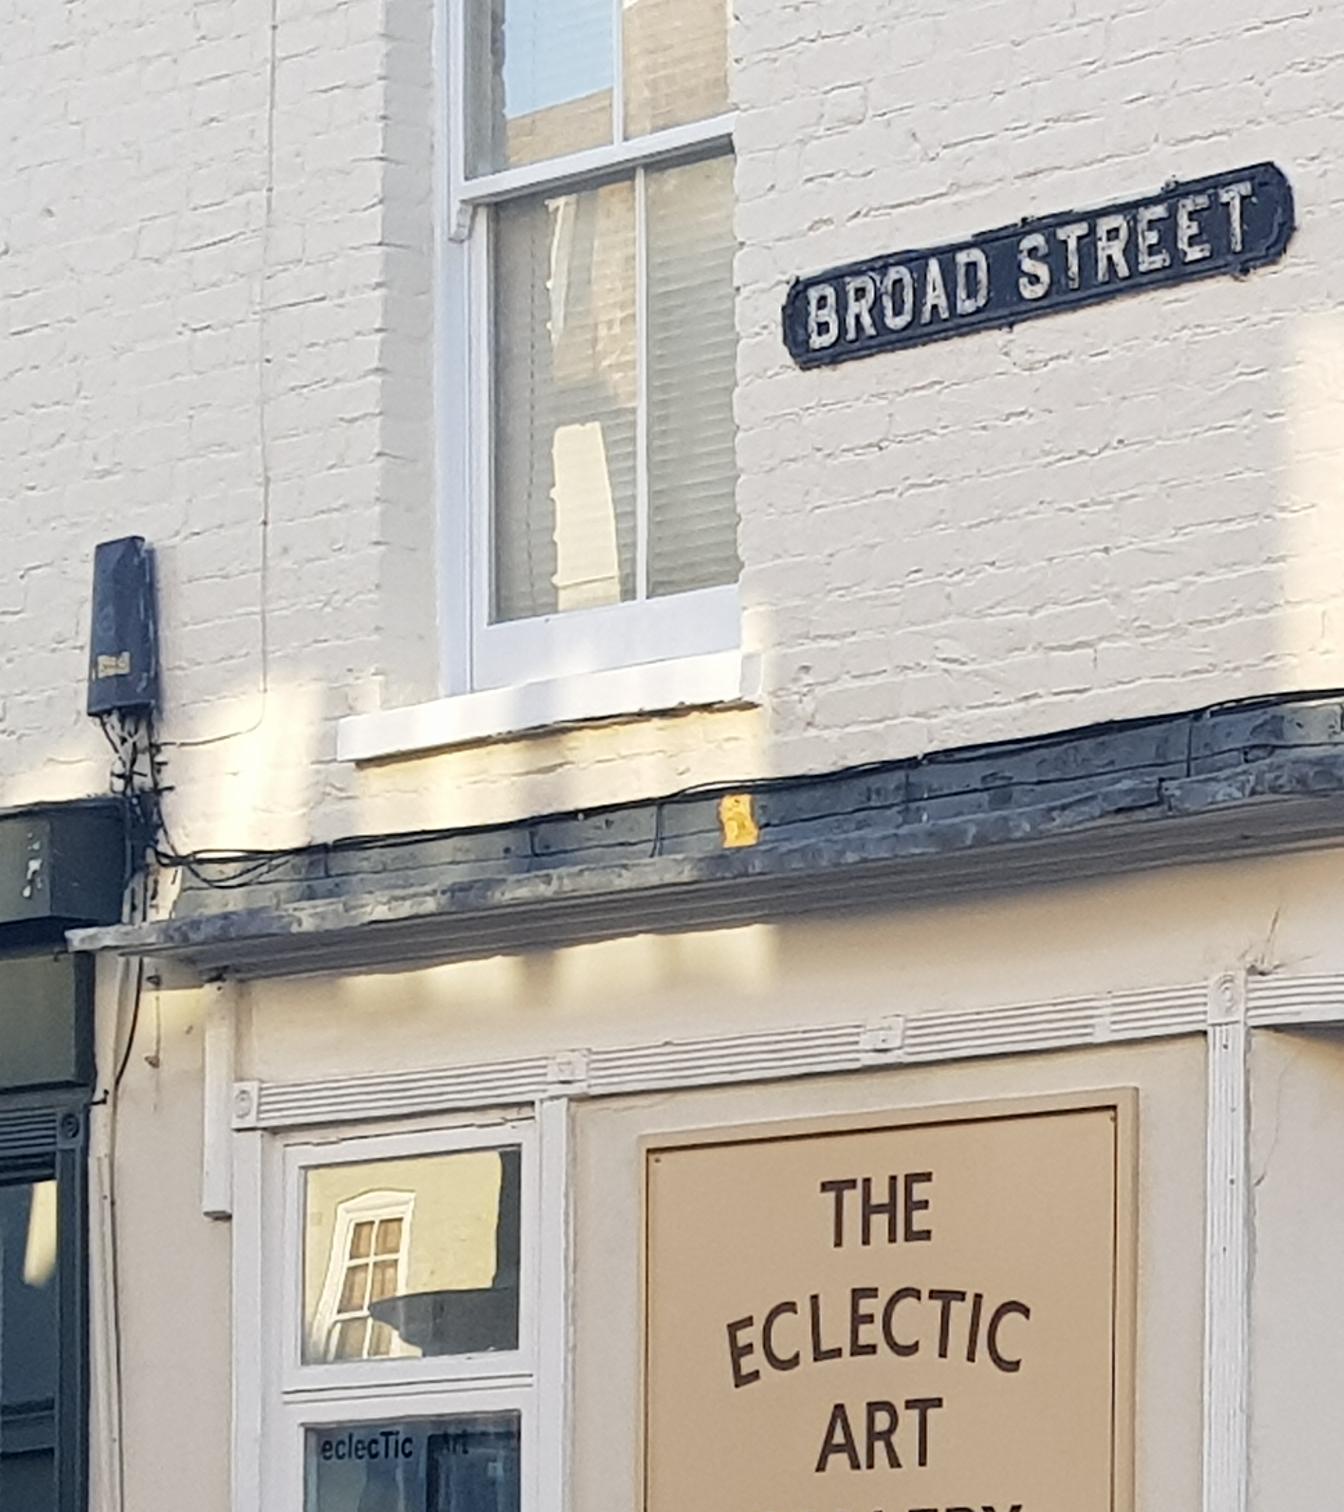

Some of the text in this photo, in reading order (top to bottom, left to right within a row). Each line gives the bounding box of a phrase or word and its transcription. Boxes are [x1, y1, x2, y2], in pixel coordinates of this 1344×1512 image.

[806, 182, 1253, 350] BROAD STREET
[819, 1170, 934, 1249] THE
[725, 1285, 1032, 1390] ECLECTIC
[320, 1430, 414, 1461] eclecTic
[814, 1396, 945, 1474] ART
